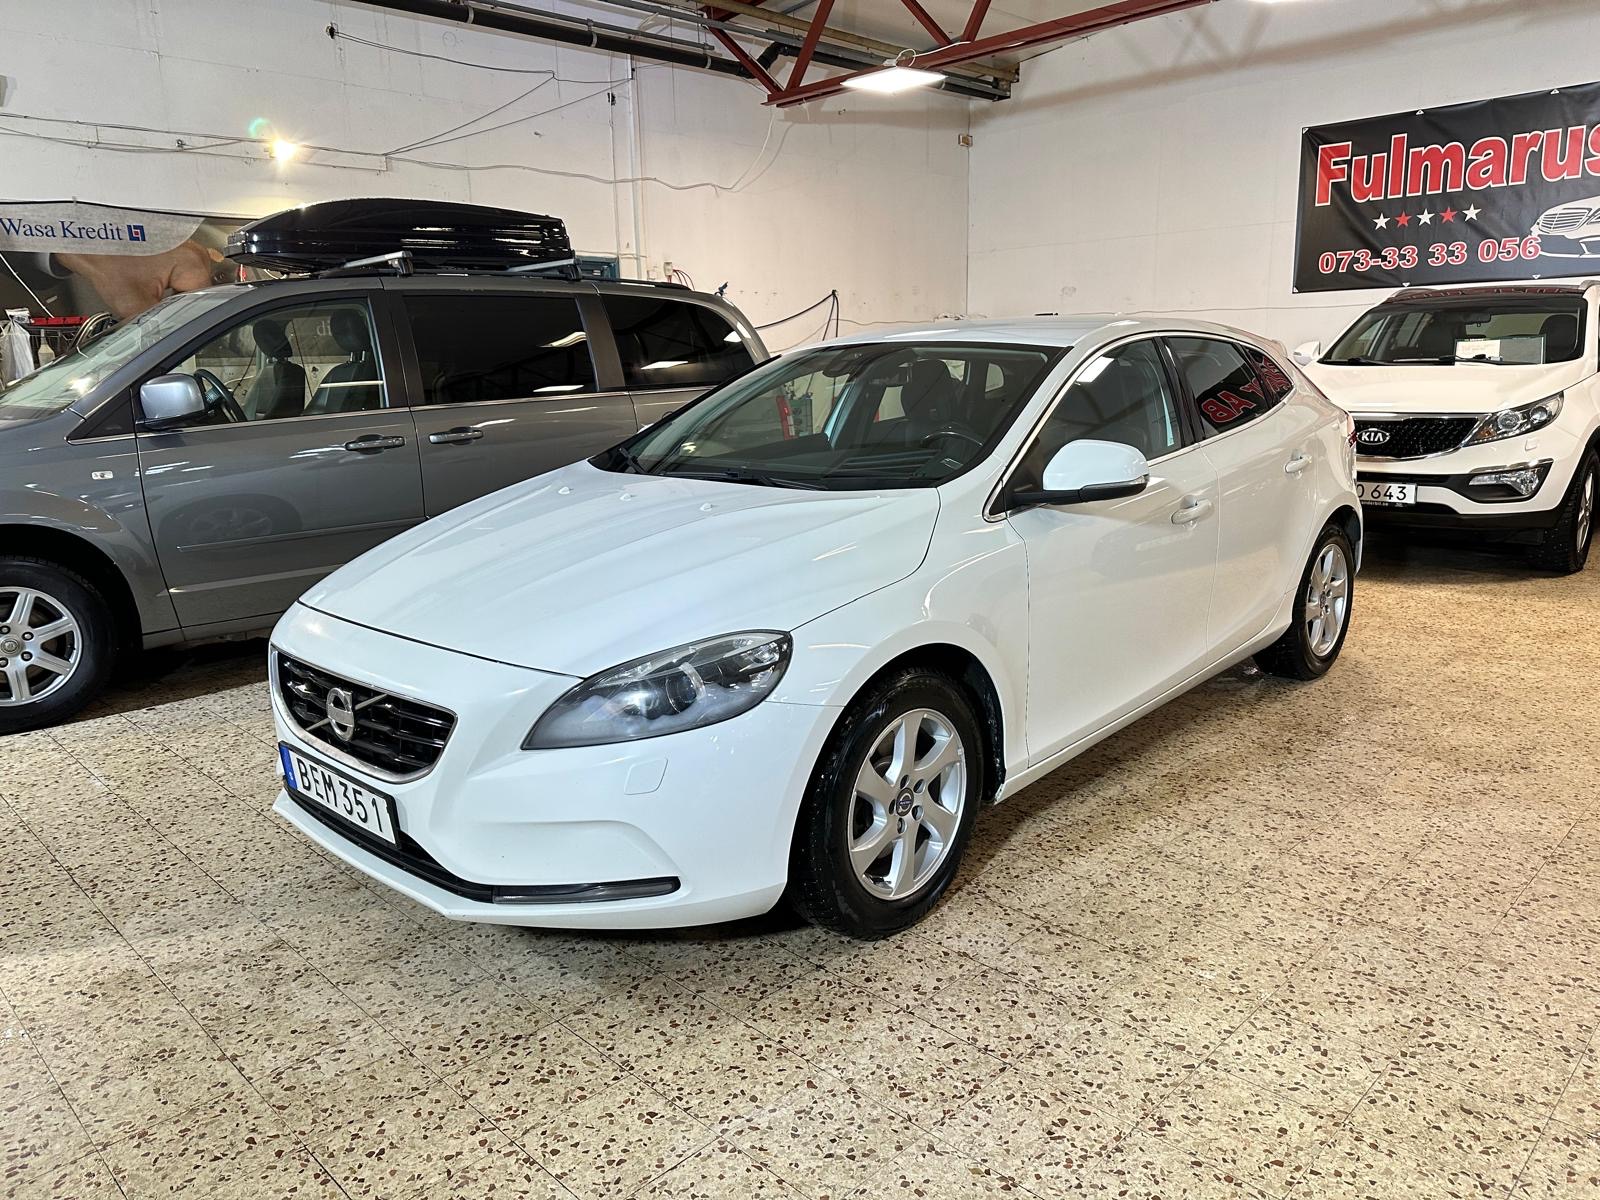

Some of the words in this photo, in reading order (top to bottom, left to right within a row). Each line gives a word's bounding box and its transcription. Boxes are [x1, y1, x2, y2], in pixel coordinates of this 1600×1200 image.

[0, 217, 56, 238] Wasa
[59, 220, 123, 240] Kredit
[1318, 245, 1418, 274] 073-33
[1428, 241, 1467, 267] 33
[1478, 236, 1542, 261] 056
[1361, 432, 1383, 442] KIA
[1371, 484, 1407, 501] 643
